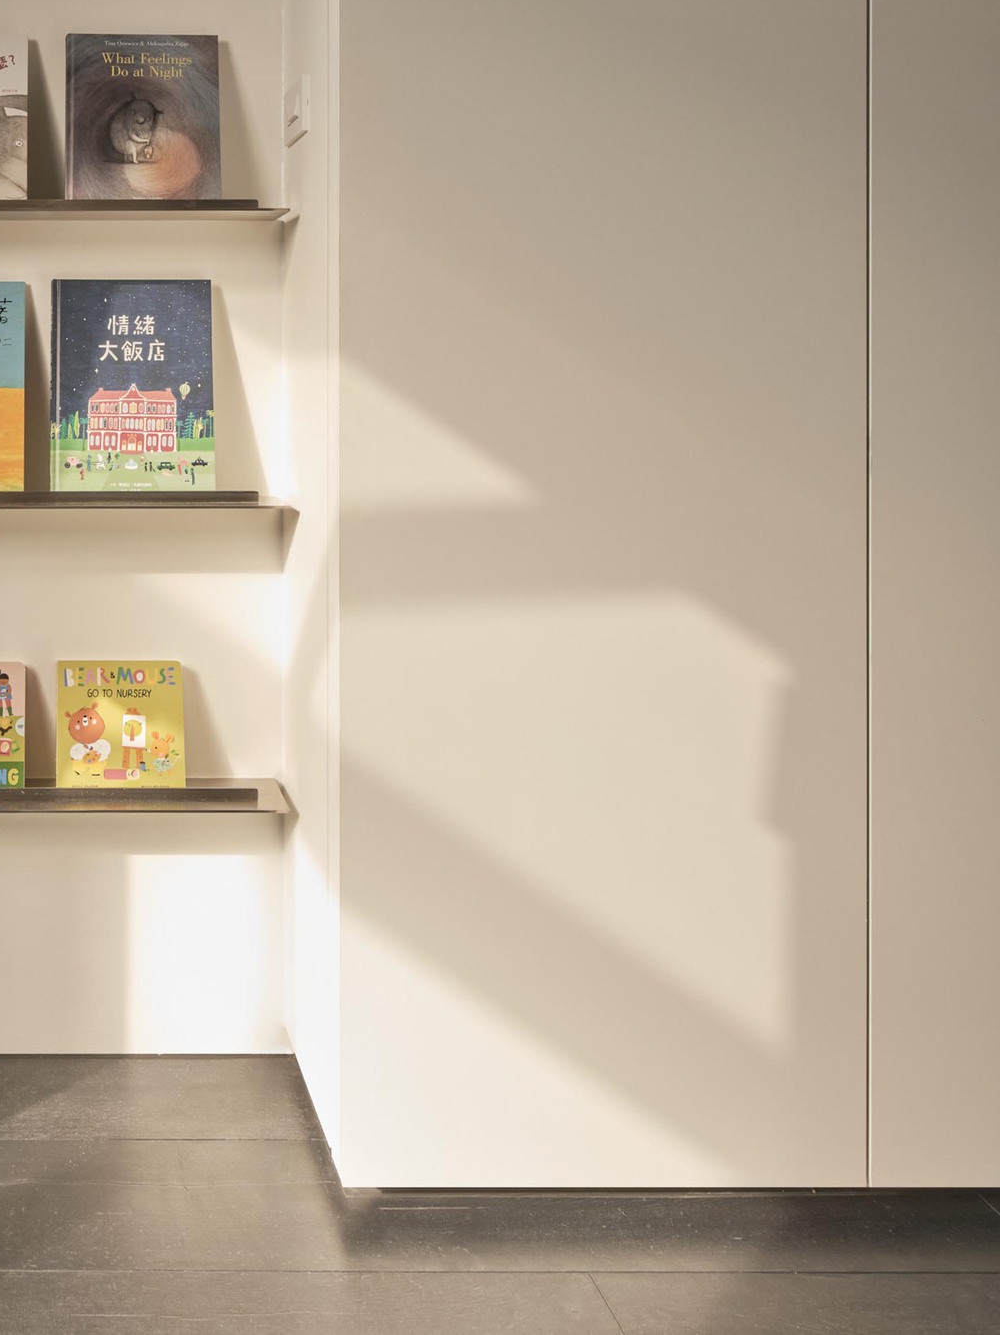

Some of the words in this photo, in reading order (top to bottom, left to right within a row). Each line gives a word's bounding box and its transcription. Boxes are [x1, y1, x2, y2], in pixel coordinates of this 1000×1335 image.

[101, 52, 136, 65] What
[140, 52, 193, 67] Feelings
[110, 66, 129, 78] Do
[132, 67, 145, 78] at
[150, 66, 184, 80] Night
[107, 314, 155, 335] 情緒
[98, 339, 166, 362] 大飯店
[64, 667, 110, 687] BEAR
[110, 671, 116, 679] &
[116, 666, 176, 685] MOUSE
[87, 688, 99, 698] GO
[102, 688, 113, 698] TO
[116, 688, 152, 698] NURSERY
